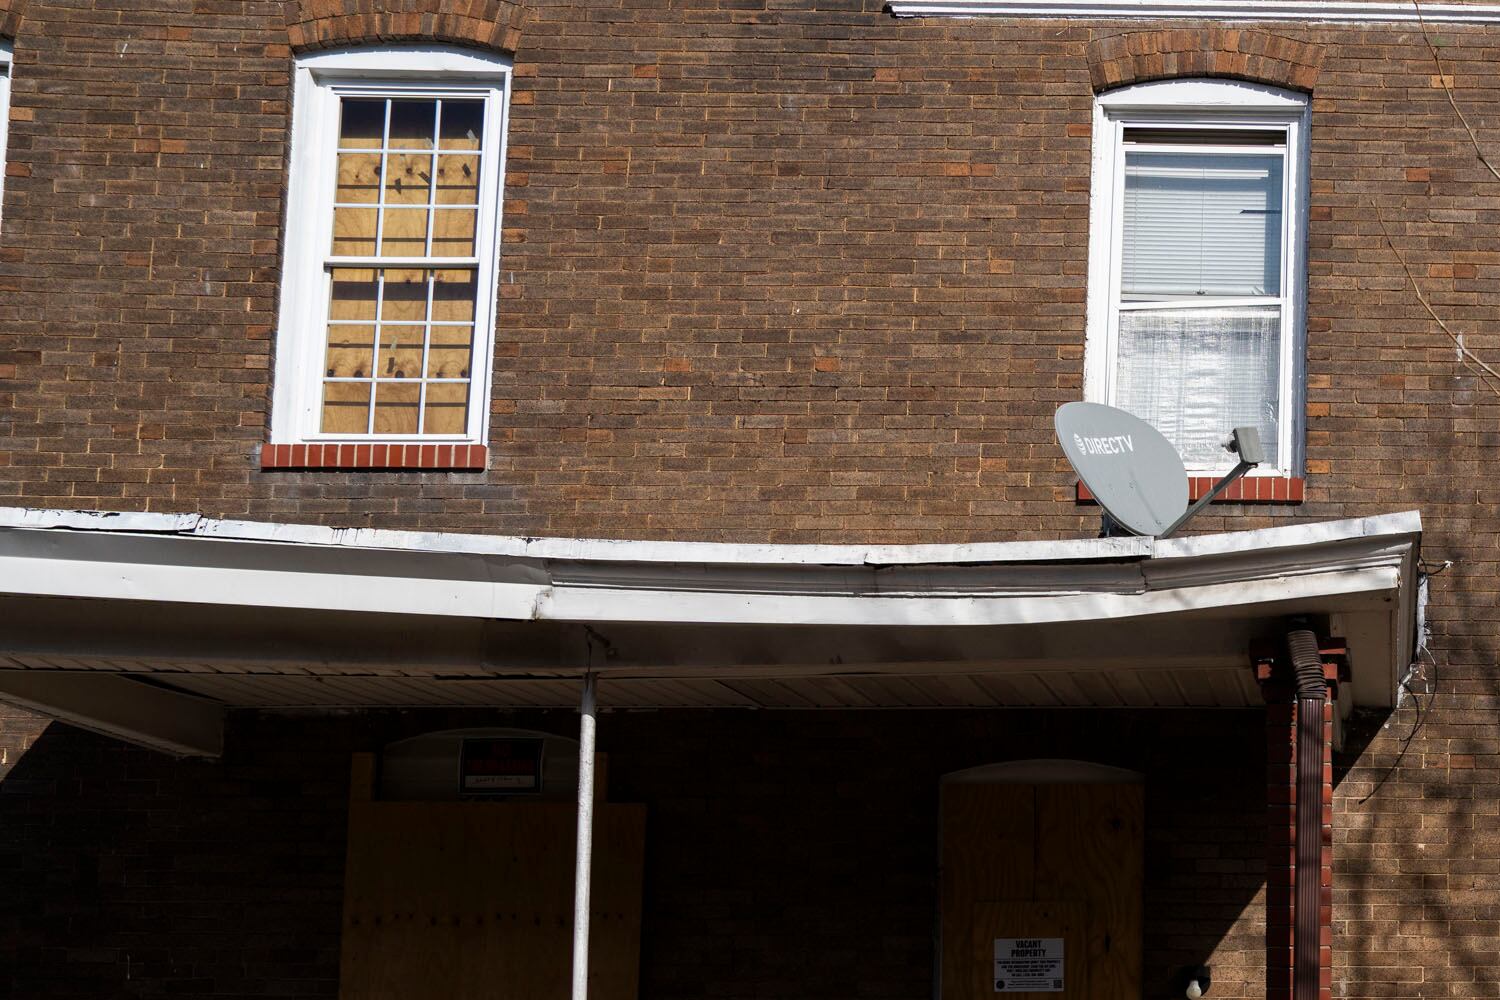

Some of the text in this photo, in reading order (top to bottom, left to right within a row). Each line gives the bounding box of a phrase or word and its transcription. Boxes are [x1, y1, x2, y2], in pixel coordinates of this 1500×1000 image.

[1085, 435, 1134, 455] DIRECTV
[1016, 940, 1041, 948] VACANT
[1011, 949, 1046, 957] PROPERTY
